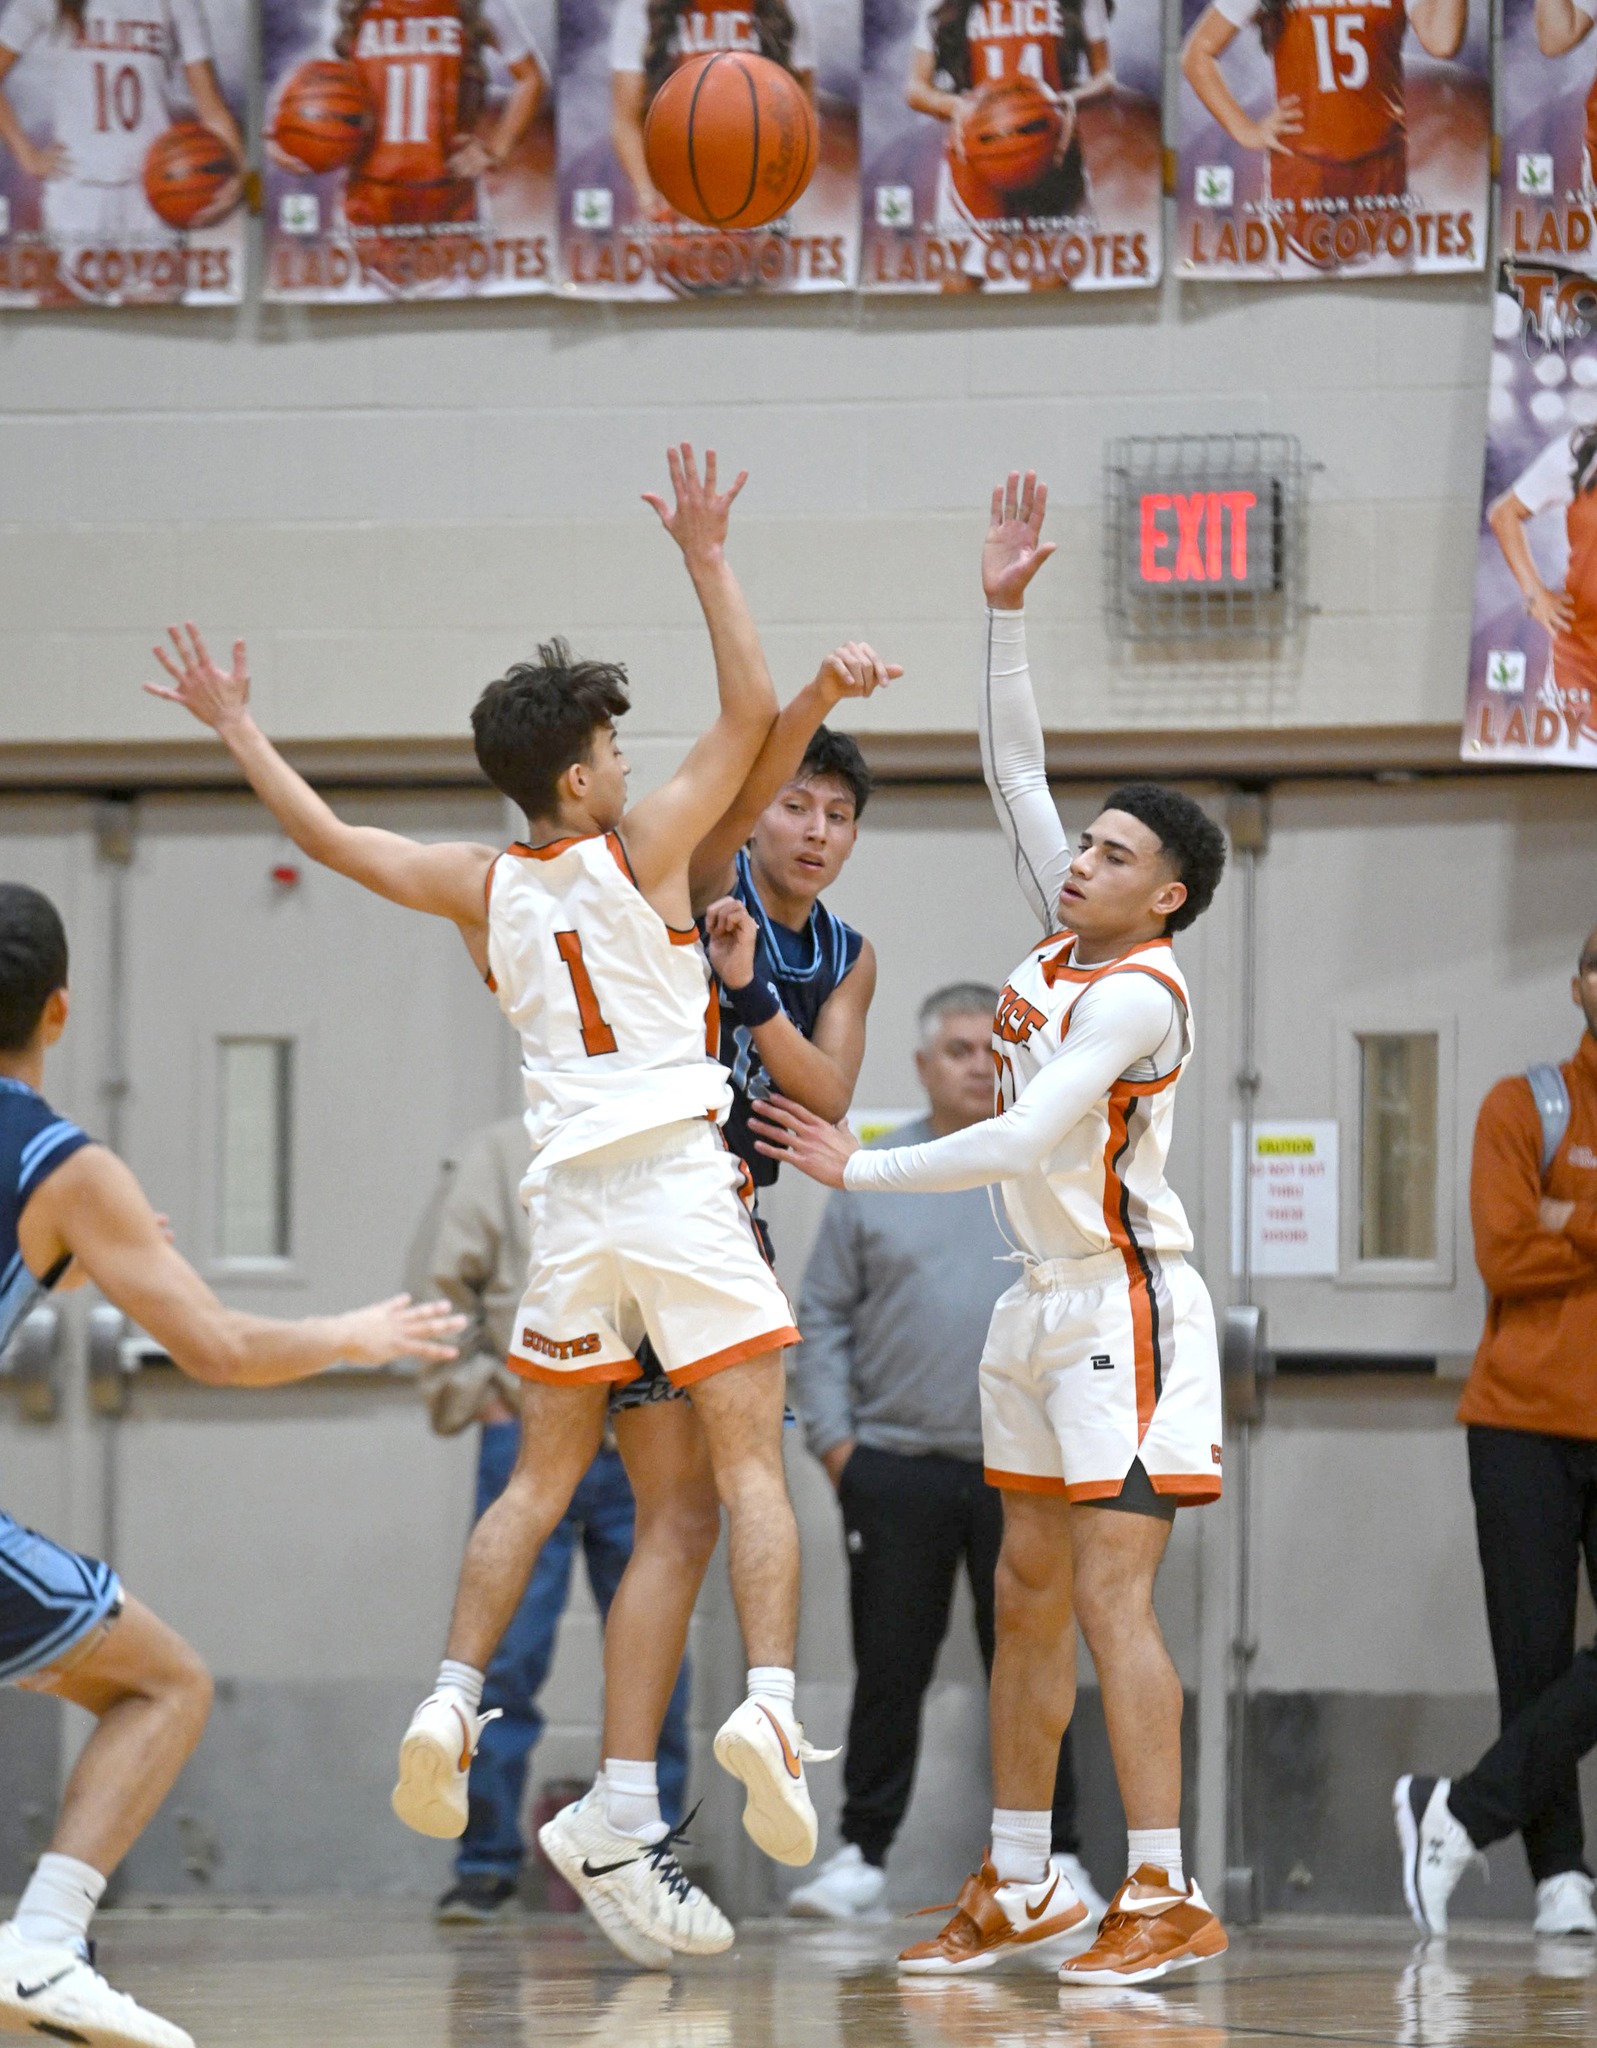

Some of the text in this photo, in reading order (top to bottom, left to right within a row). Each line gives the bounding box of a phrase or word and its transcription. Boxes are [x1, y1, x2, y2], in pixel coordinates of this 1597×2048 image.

[356, 16, 463, 59] ALICE
[1310, 14, 1370, 93] 15
[94, 62, 143, 132] 10
[384, 63, 429, 143] 11
[1193, 212, 1474, 263] LADY COYOTES
[1515, 208, 1597, 253] LAD
[76, 248, 230, 289] COYOTES
[876, 232, 1147, 282] LADY COYOTES
[1140, 491, 1257, 582] EXIT
[1480, 706, 1585, 750] LADY
[554, 929, 618, 1057] 1
[522, 1327, 602, 1360] COYOTES
